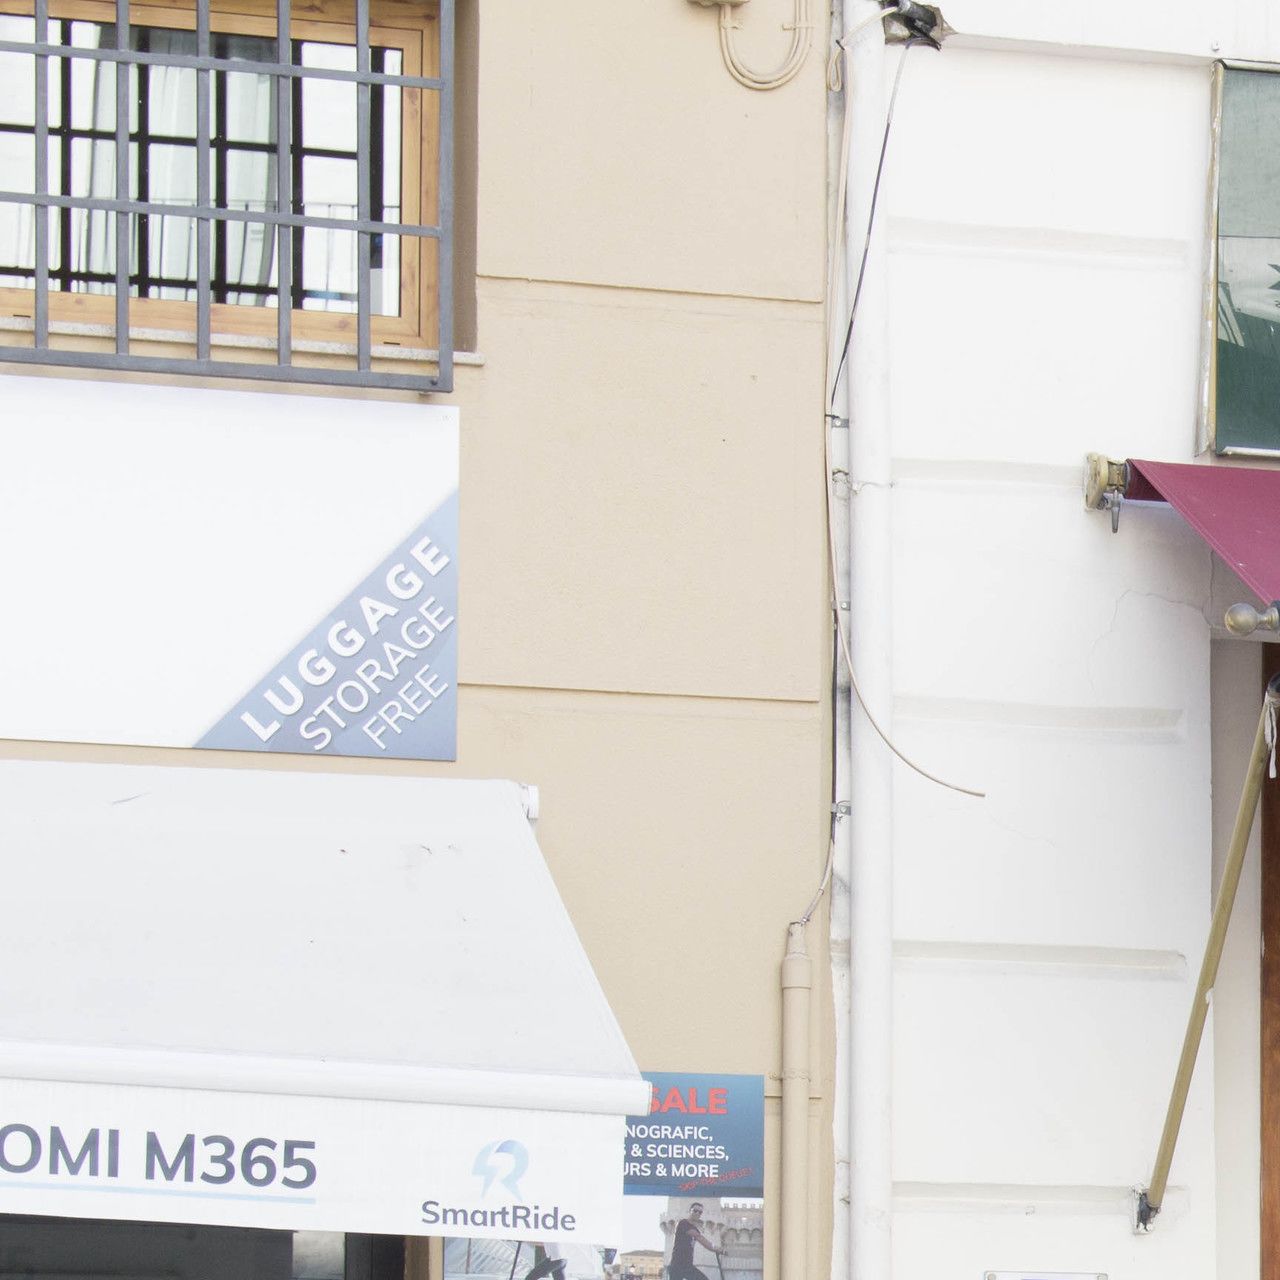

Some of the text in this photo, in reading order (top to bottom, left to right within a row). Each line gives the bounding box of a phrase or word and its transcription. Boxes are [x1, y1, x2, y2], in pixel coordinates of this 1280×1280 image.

[240, 535, 450, 742] LUGGAGE
[299, 597, 455, 750] STORAGE
[362, 664, 449, 748] FREE
[0, 1123, 317, 1189] OMI M365
[631, 1145, 643, 1157] &
[647, 1145, 729, 1161] SCIENCES,
[656, 1163, 668, 1177] &
[672, 1163, 719, 1178] MORE
[421, 1200, 577, 1232] SmartRide
